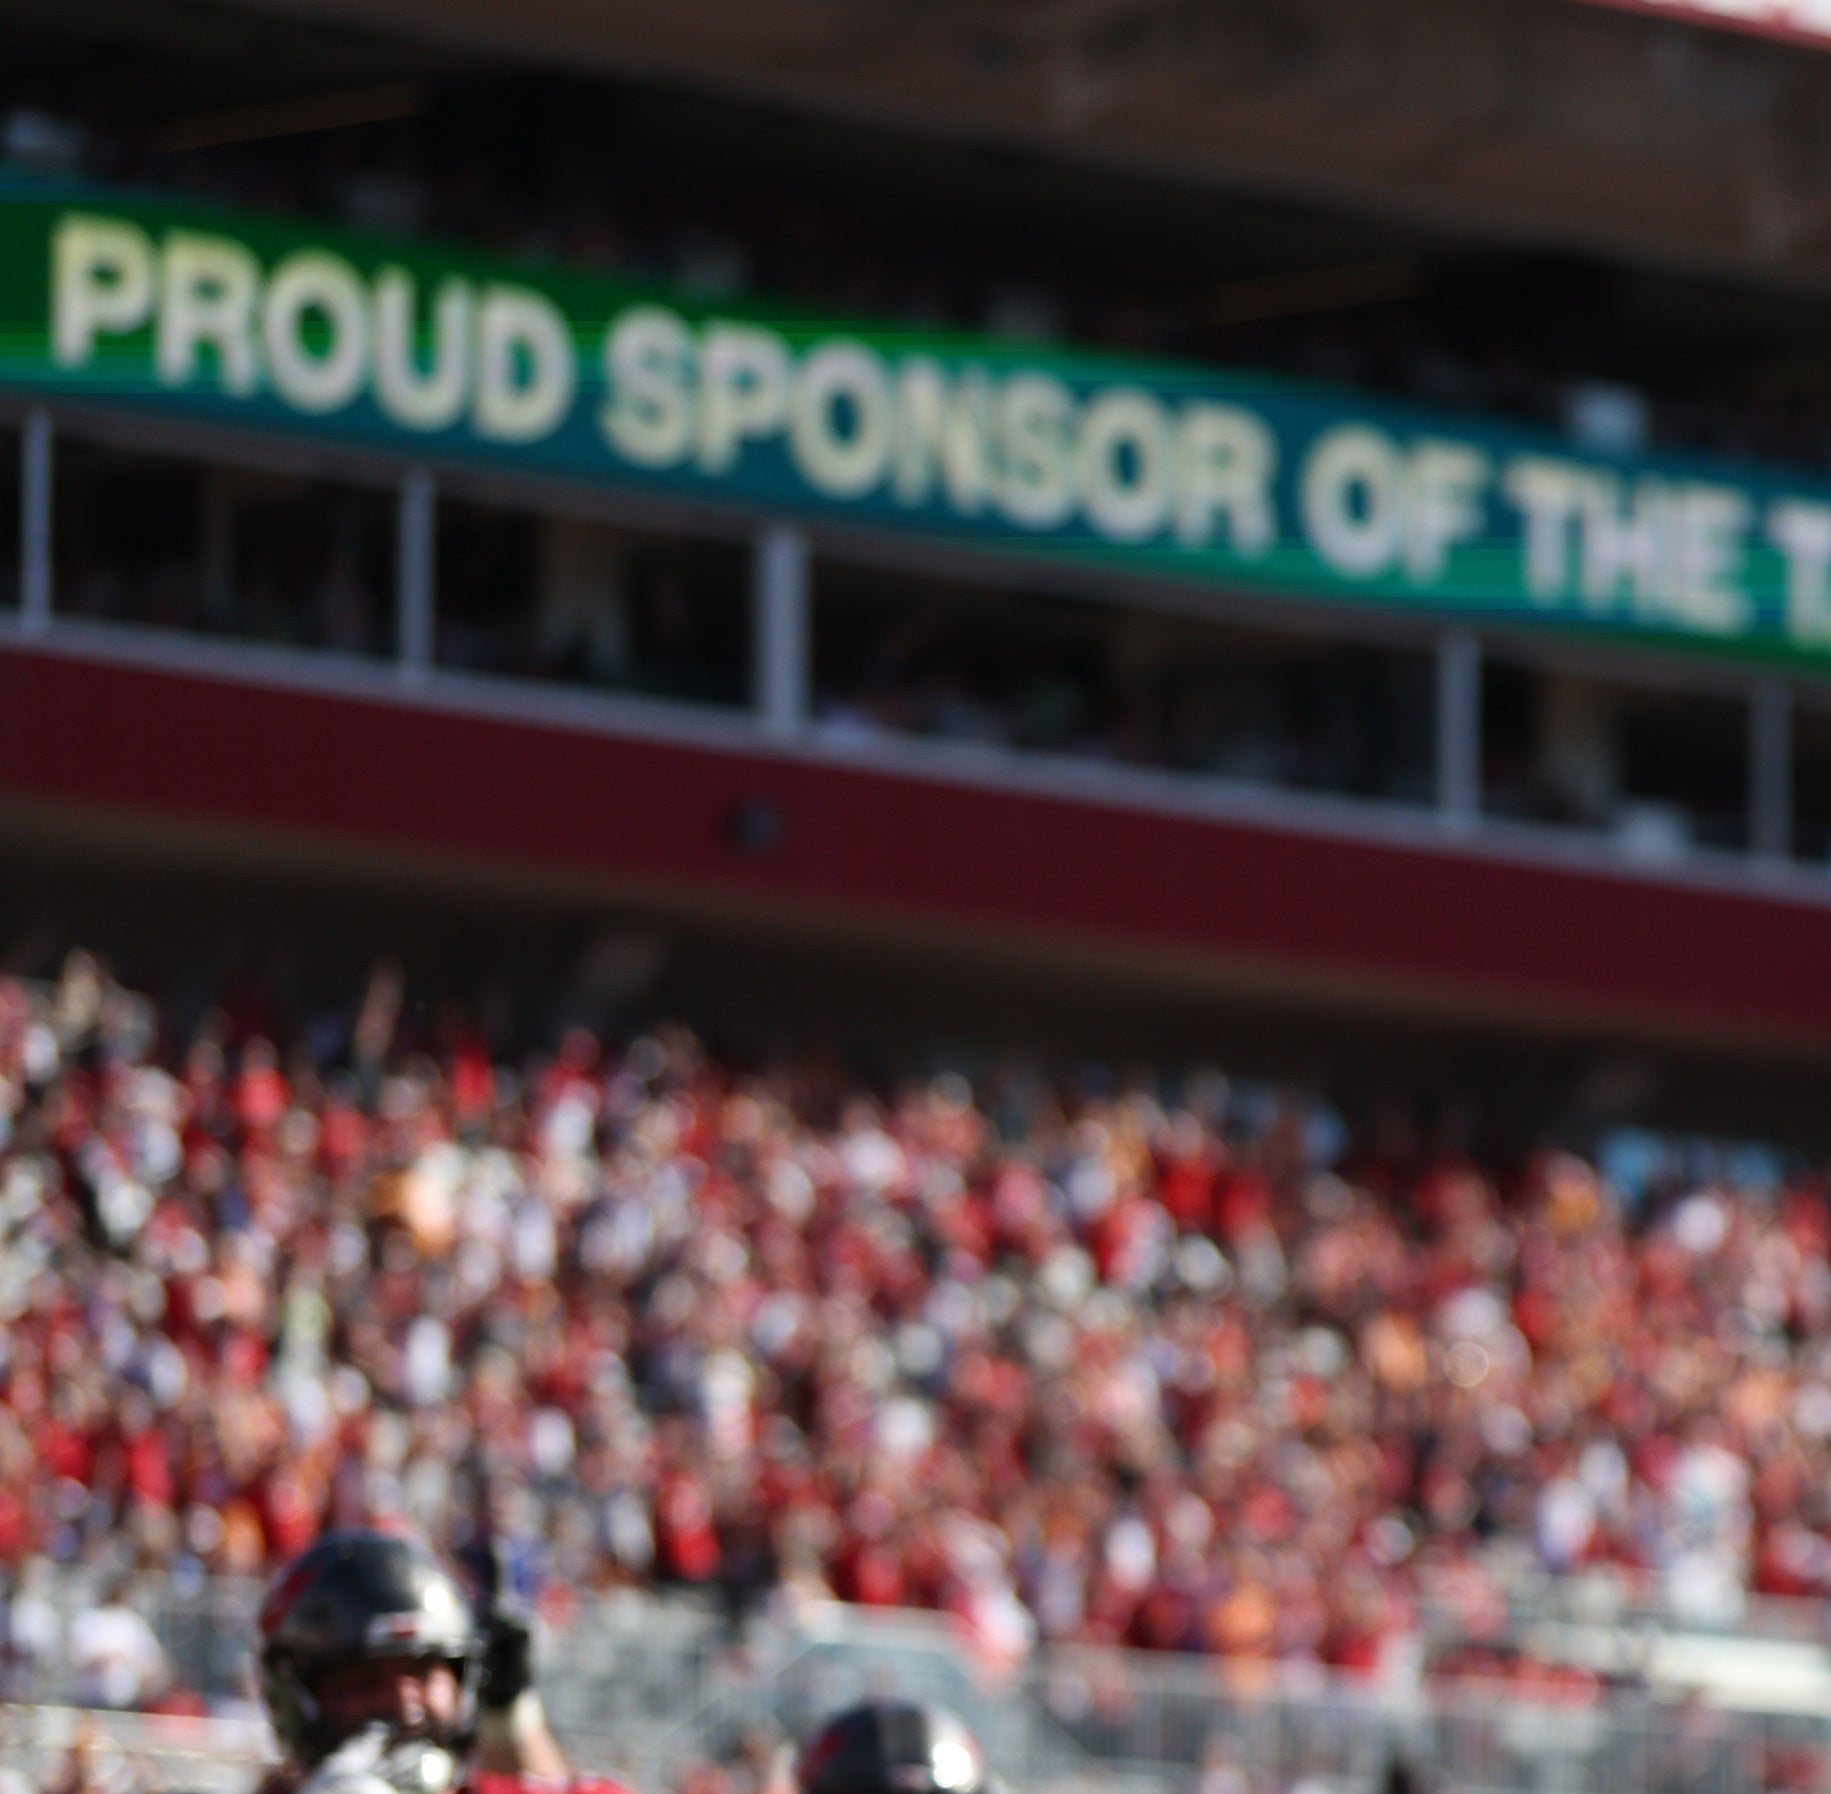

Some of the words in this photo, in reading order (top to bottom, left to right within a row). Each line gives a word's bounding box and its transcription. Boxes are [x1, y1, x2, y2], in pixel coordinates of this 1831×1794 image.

[54, 214, 576, 440] PROUD
[601, 307, 1276, 555] SPONSOR
[1303, 424, 1484, 584] OF
[1508, 457, 1756, 628] THE
